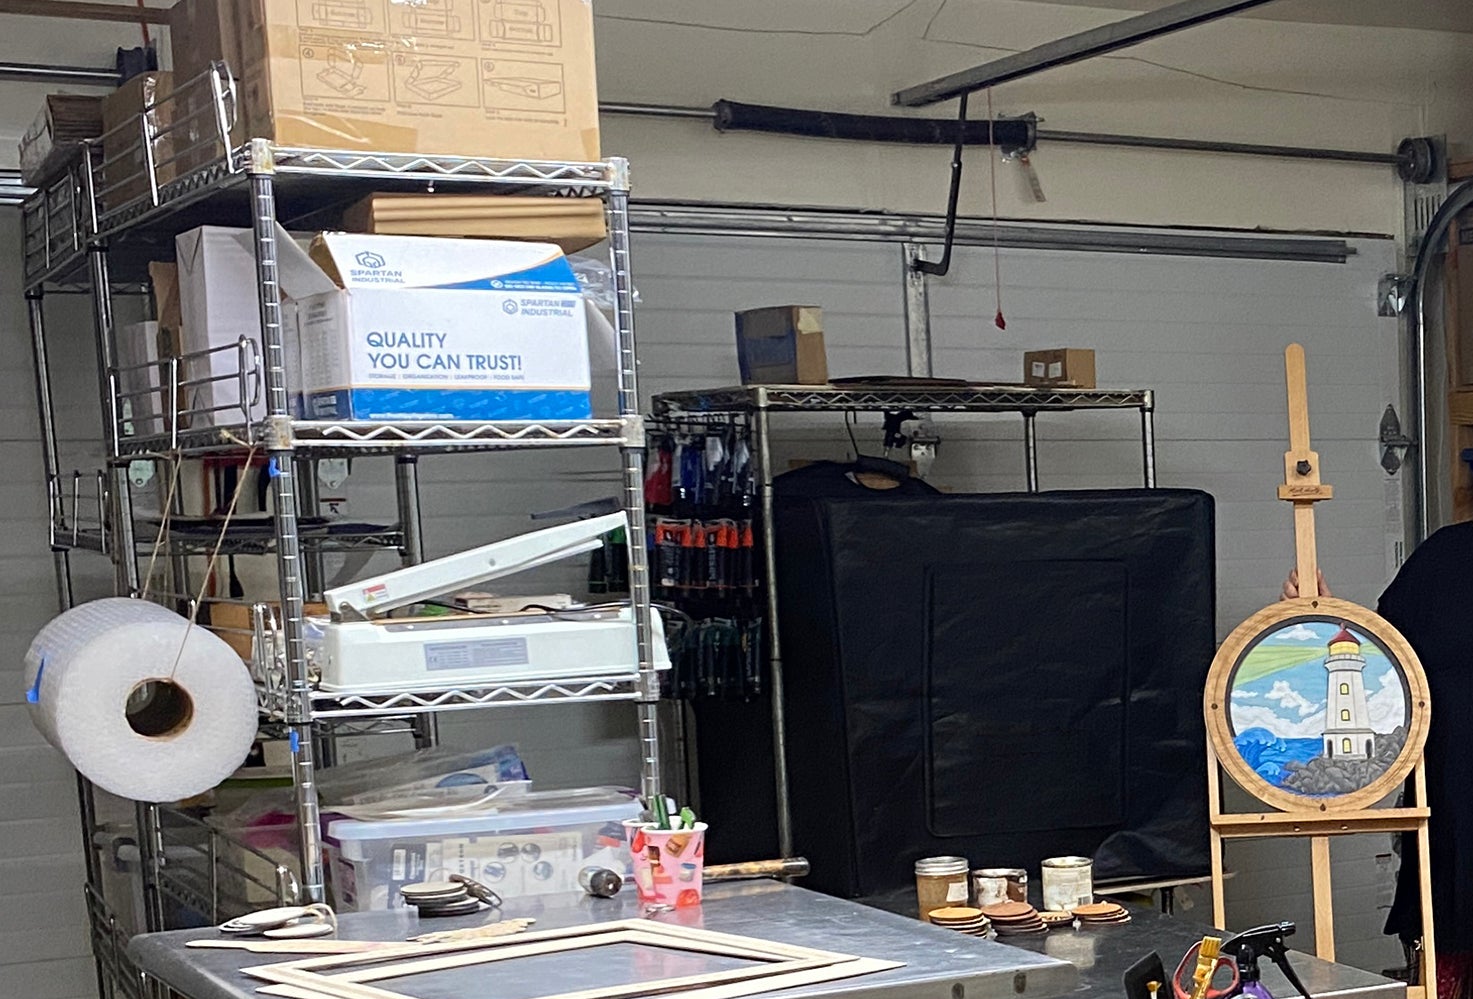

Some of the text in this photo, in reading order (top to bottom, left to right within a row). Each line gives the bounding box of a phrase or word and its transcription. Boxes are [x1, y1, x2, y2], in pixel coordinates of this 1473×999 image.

[520, 309, 574, 317] INDUSTRIAL
[366, 332, 447, 349] QUALITY
[367, 352, 522, 371] YOU CAN TRUST!
